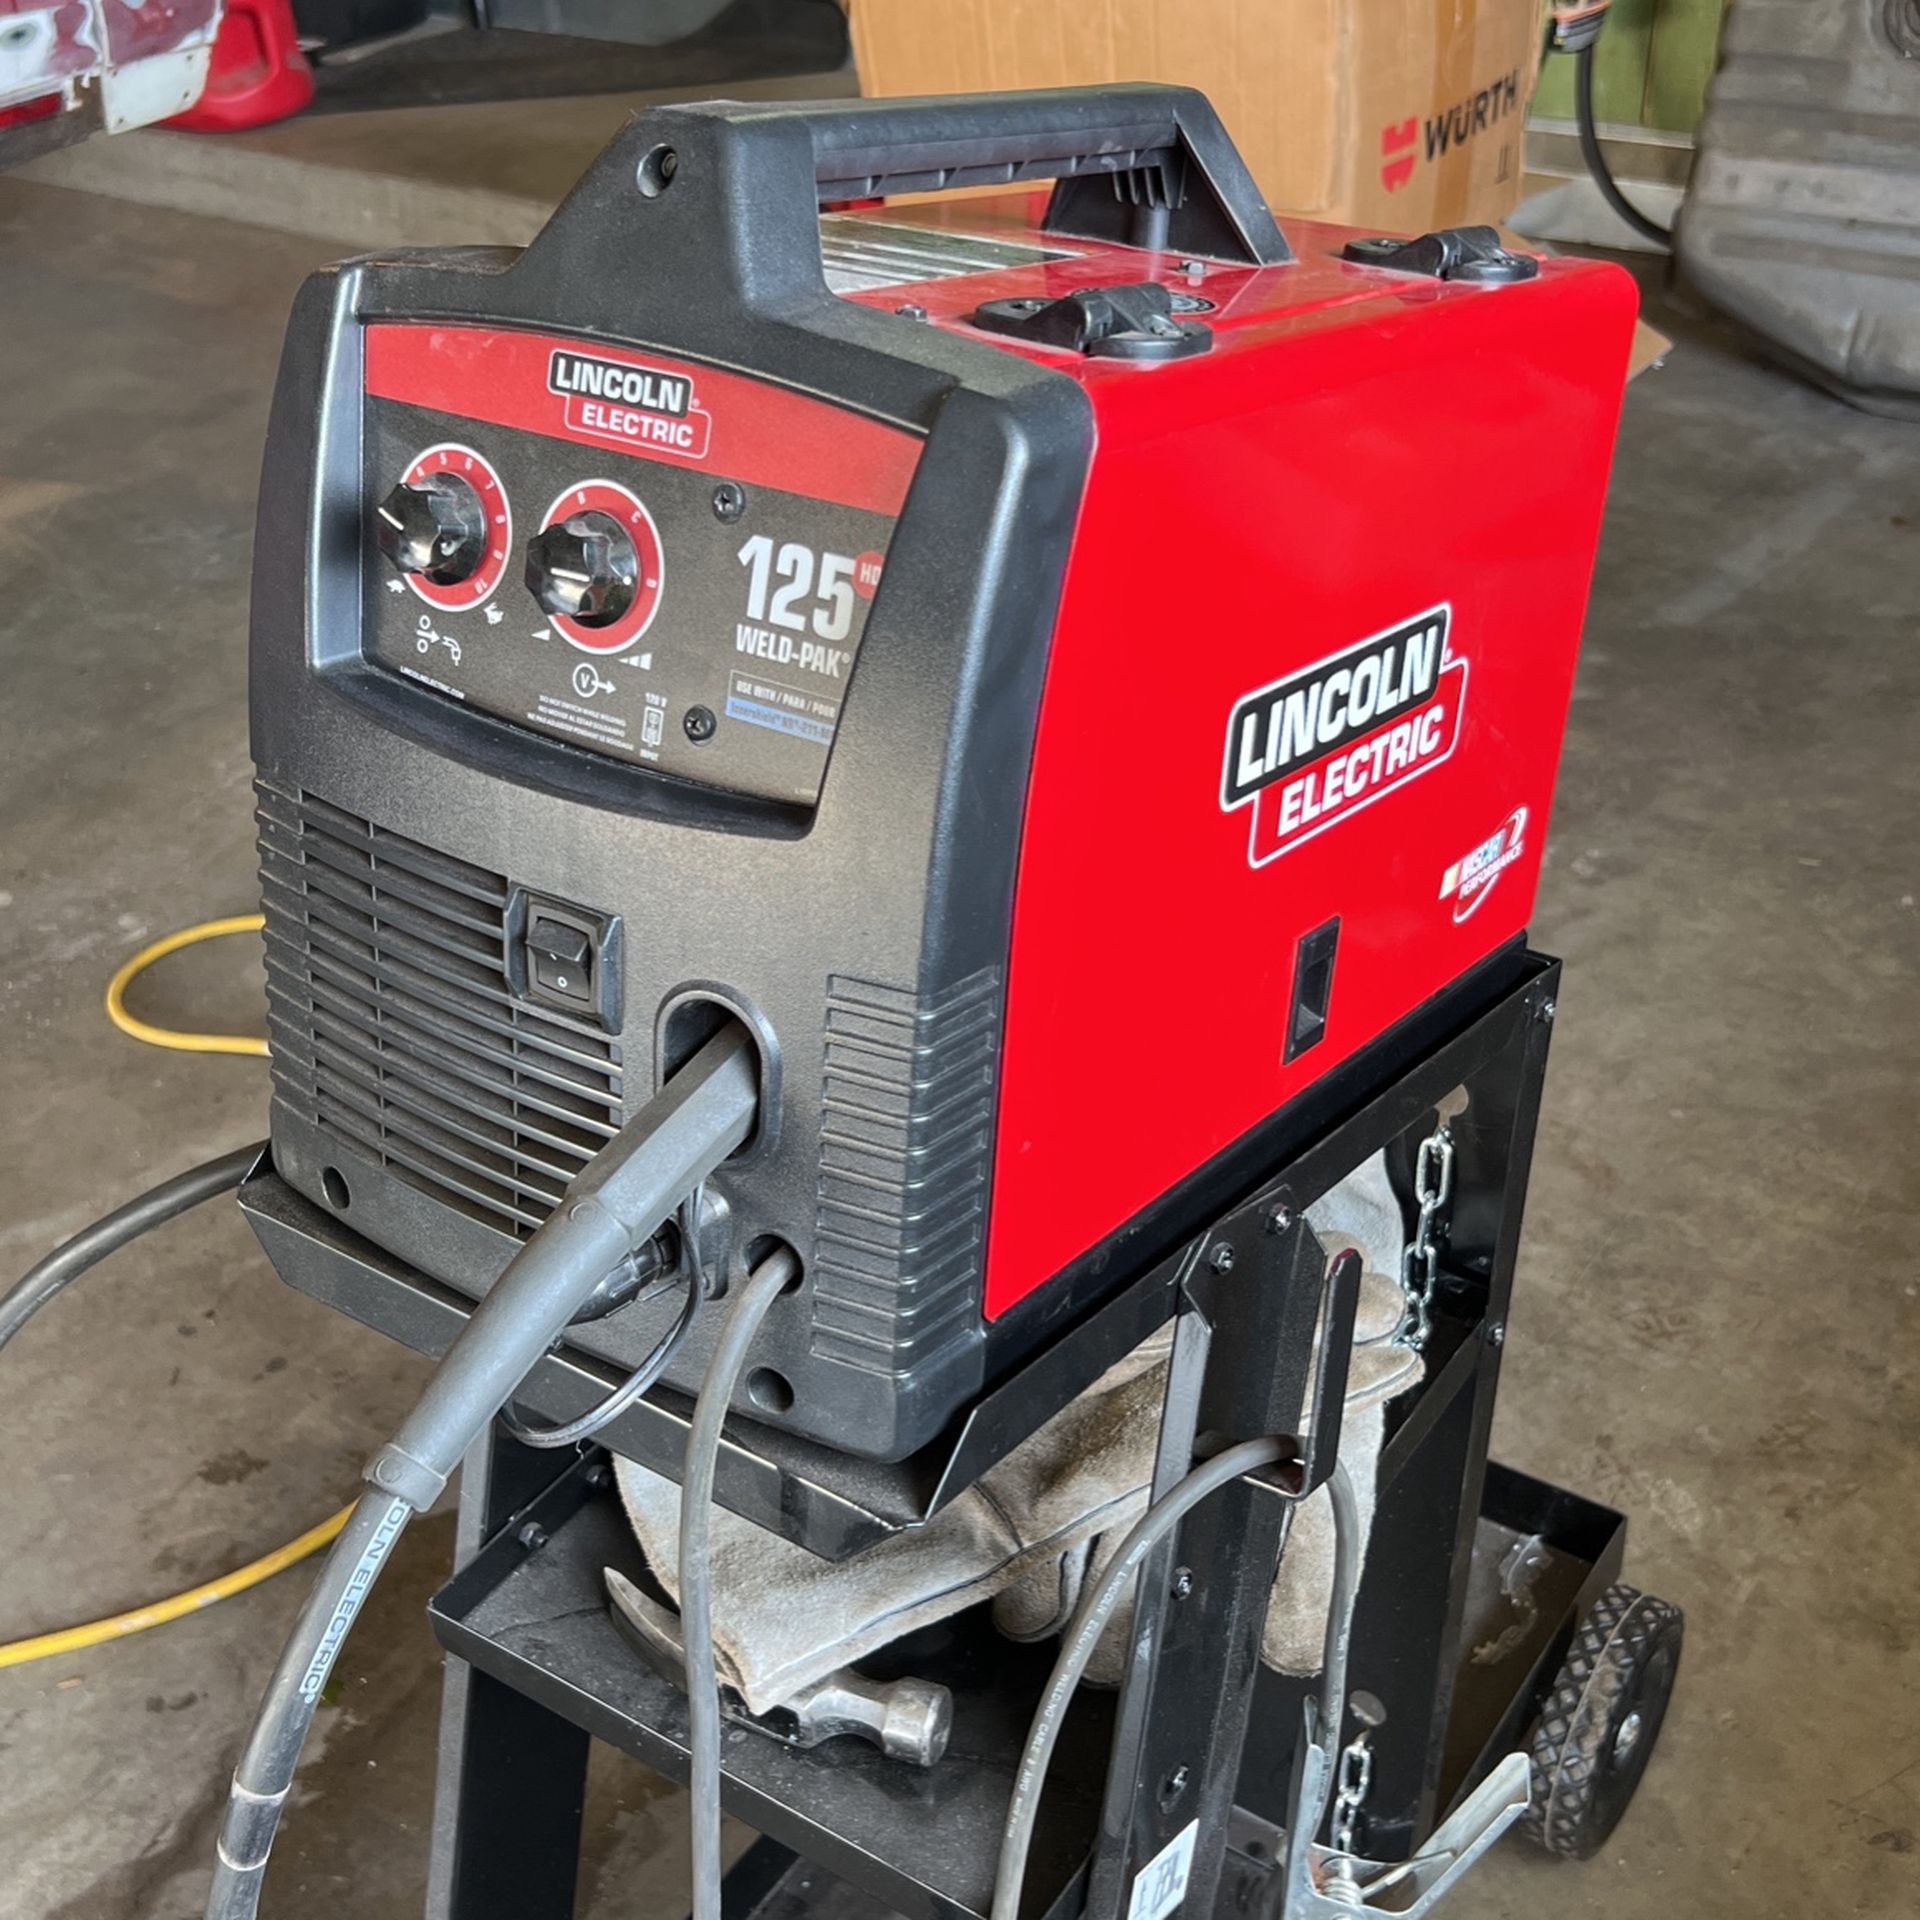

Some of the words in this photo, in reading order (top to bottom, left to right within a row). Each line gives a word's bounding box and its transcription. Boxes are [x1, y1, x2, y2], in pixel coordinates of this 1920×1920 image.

[1426, 67, 1519, 162] WÜRTH
[556, 357, 684, 413] LINCOLN
[581, 402, 693, 447] ELECTRIC
[439, 452, 447, 465] 5
[464, 457, 473, 470] 6
[485, 479, 495, 490] 7
[631, 511, 641, 524] C
[474, 579, 488, 594] 10
[737, 534, 856, 641] 125
[1236, 625, 1438, 788] LINCOLN
[1277, 704, 1443, 837] ELECTRIC
[366, 1499, 408, 1560] OLN
[1095, 1571, 1128, 1616] LINCOLN
[303, 1568, 371, 1692] ELECTRIC
